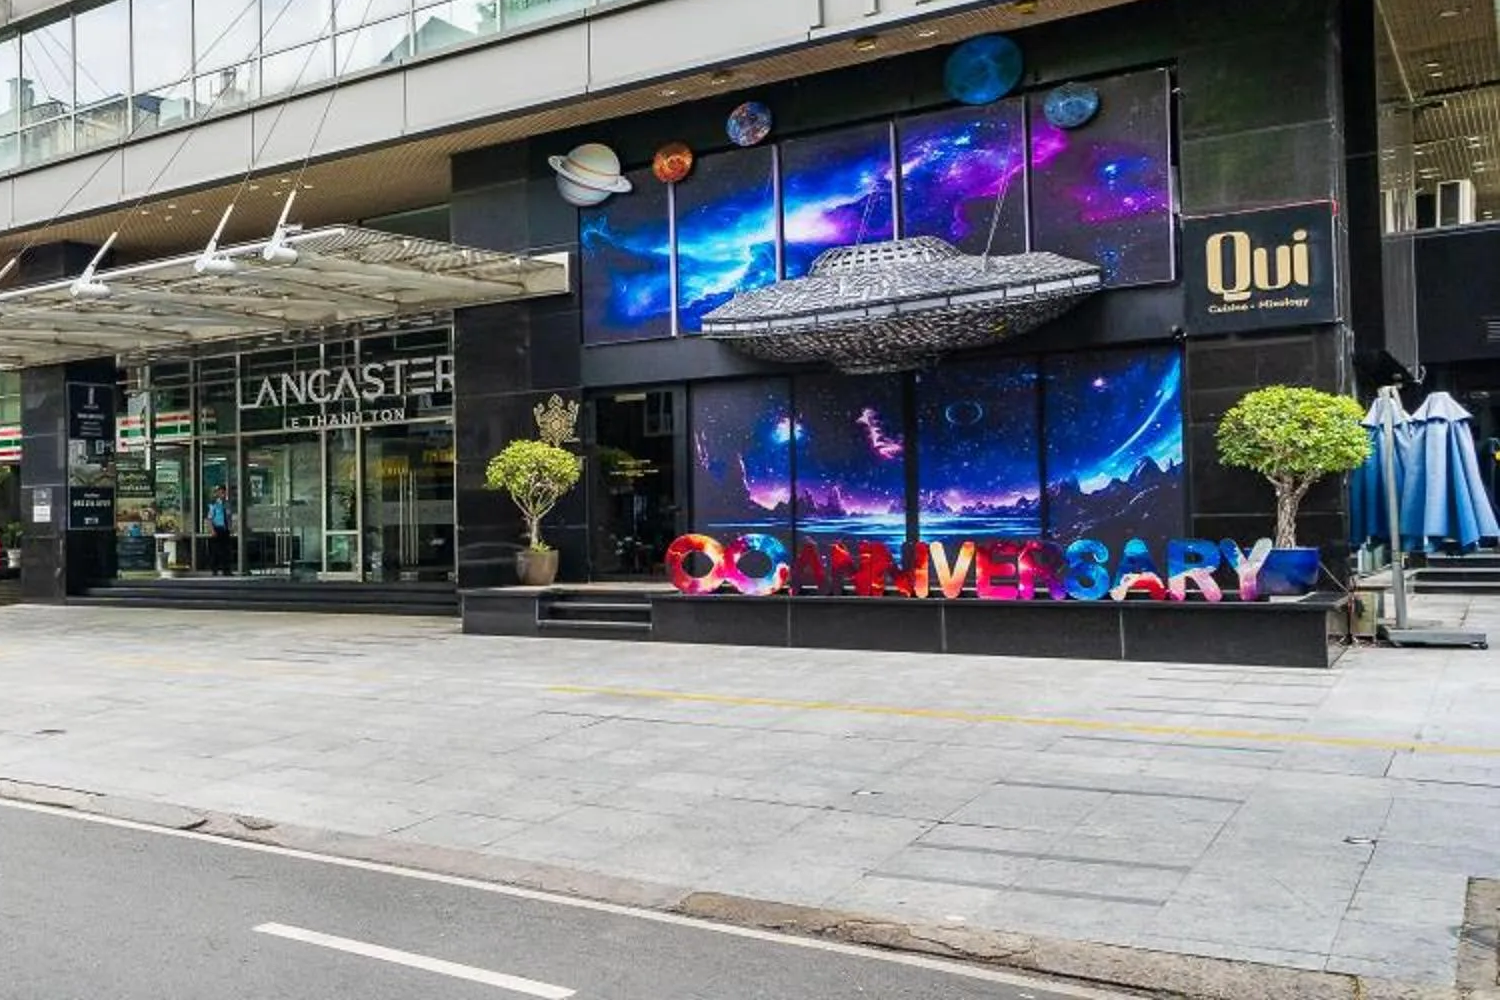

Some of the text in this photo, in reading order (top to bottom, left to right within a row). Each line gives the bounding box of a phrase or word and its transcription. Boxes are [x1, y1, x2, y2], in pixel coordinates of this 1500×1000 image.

[1206, 229, 1309, 302] Qui
[237, 355, 455, 409] LANCASTER
[308, 411, 363, 429] THANH
[792, 536, 1273, 600] ANNIVERSARY
